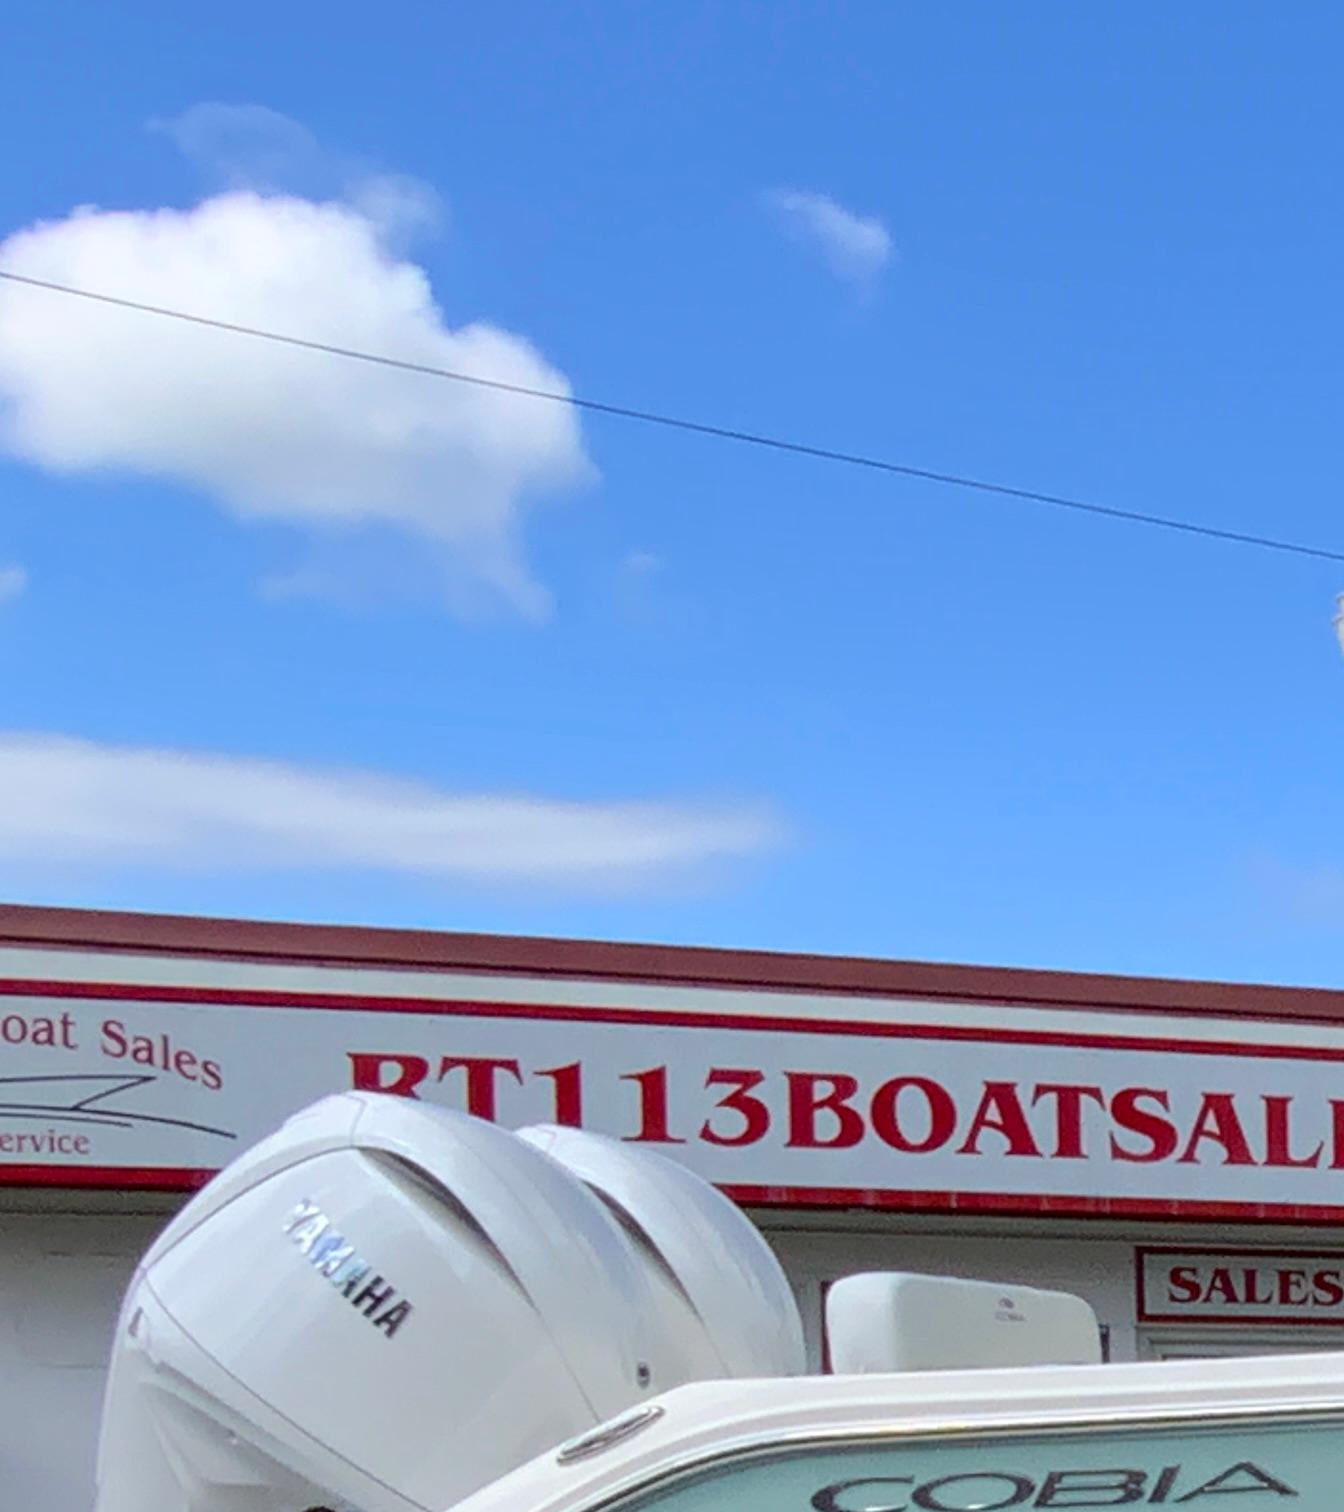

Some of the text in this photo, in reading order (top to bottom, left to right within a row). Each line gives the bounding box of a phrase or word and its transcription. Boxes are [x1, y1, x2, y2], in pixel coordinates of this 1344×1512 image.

[100, 1019, 224, 1091] Sales
[282, 1198, 415, 1340] YAMAHA
[1167, 1264, 1344, 1307] SALES
